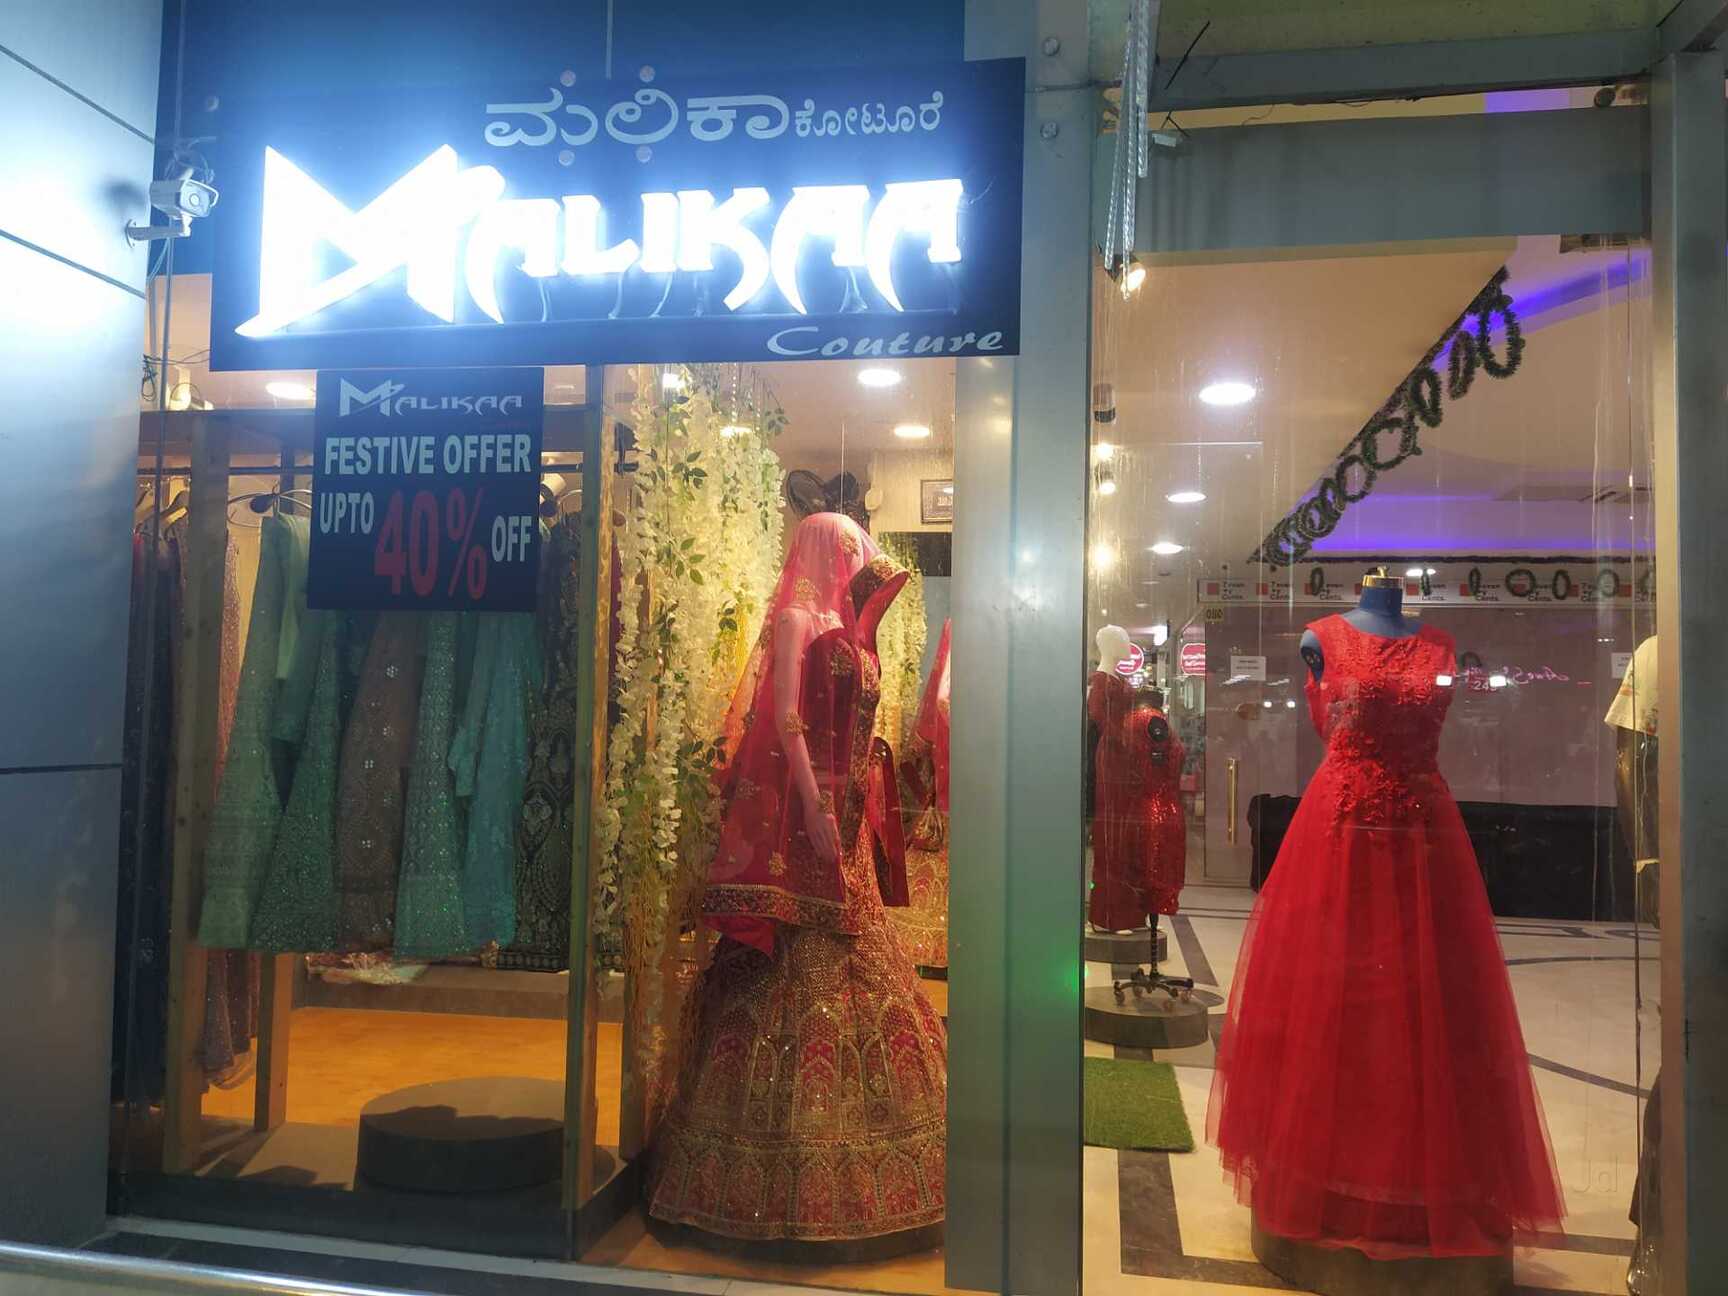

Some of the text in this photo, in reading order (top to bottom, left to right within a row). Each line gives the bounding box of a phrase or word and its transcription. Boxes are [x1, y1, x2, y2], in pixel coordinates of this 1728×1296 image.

[767, 326, 1003, 356] Couture
[324, 434, 532, 475] FESTIVE OFFER
[319, 487, 533, 601] UPTO 40% OFF
